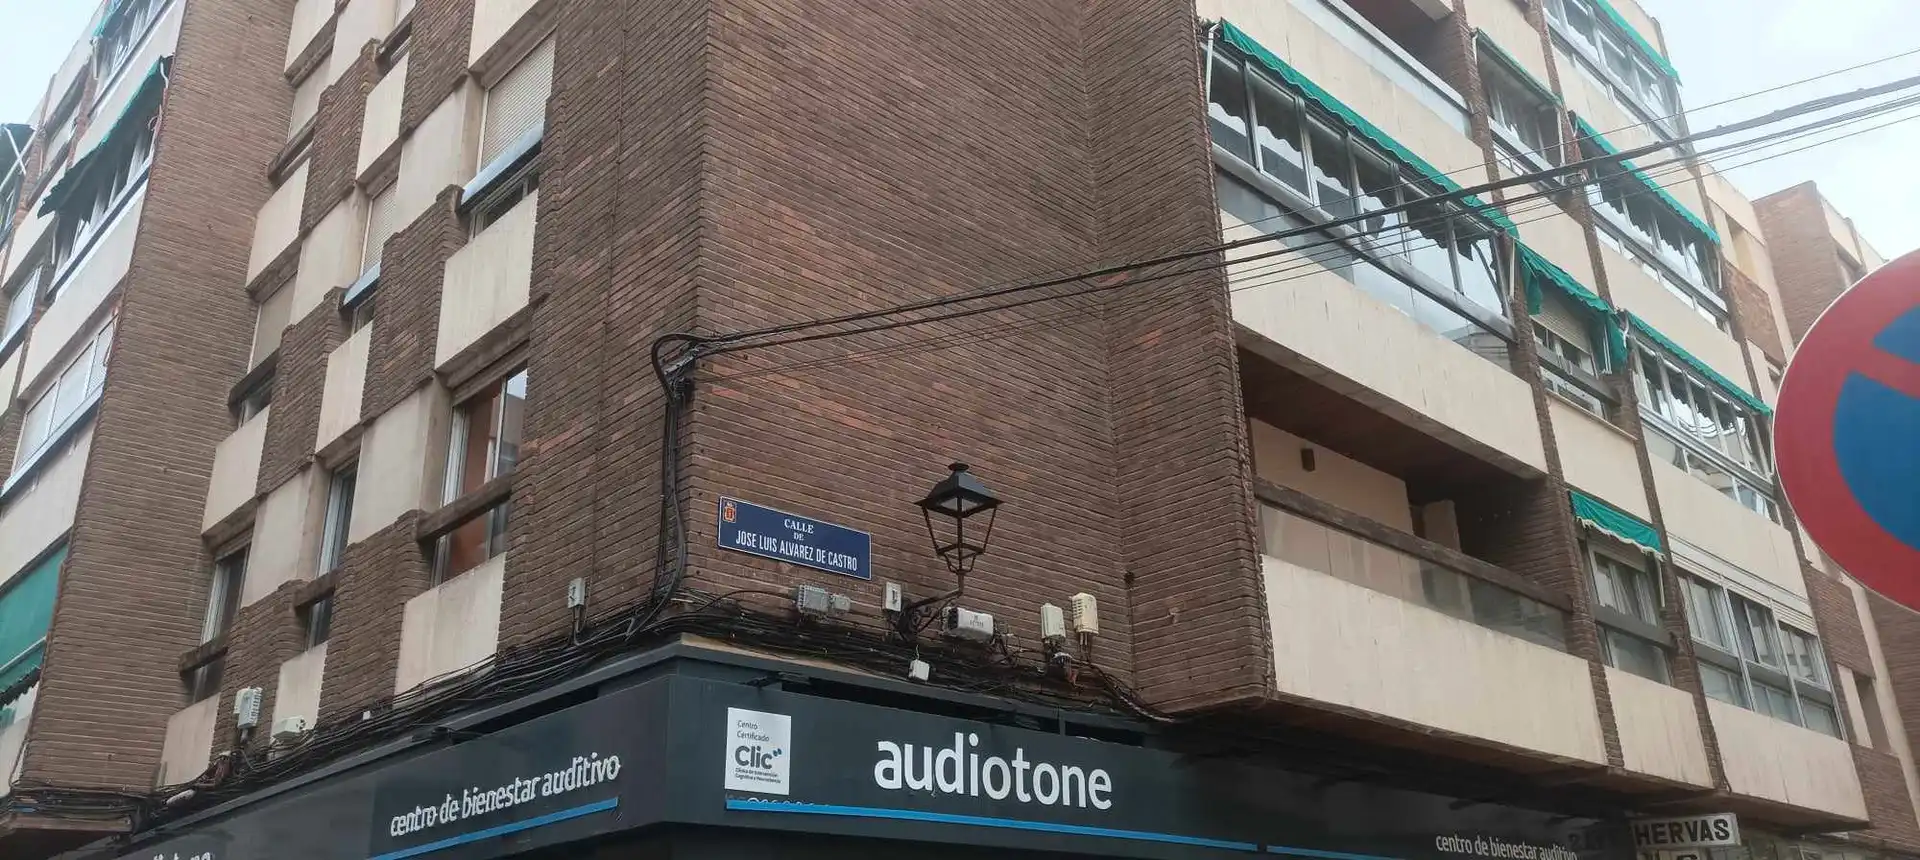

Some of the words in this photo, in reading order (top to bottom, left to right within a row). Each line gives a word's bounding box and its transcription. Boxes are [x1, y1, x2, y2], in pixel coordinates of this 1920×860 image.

[784, 518, 814, 534] CALLE
[793, 532, 804, 541] DE
[735, 530, 756, 547] JOSE
[759, 535, 777, 553] LUIS
[779, 540, 814, 562] ALVAREZ
[816, 548, 826, 564] DE
[828, 551, 858, 572] CASTRO
[736, 730, 770, 742] Certificado
[737, 720, 759, 730] Centro
[735, 745, 773, 769] Clic
[873, 731, 1113, 810] audiotone
[390, 806, 438, 837] centro
[439, 794, 459, 824] de
[461, 777, 541, 819] bienestar
[541, 752, 621, 797] auditivo
[1633, 818, 1731, 845] HERVAS
[1435, 835, 1473, 854] centro
[1474, 835, 1489, 857] de
[1489, 836, 1538, 860] bienestar
[1538, 843, 1578, 860] auditivo
